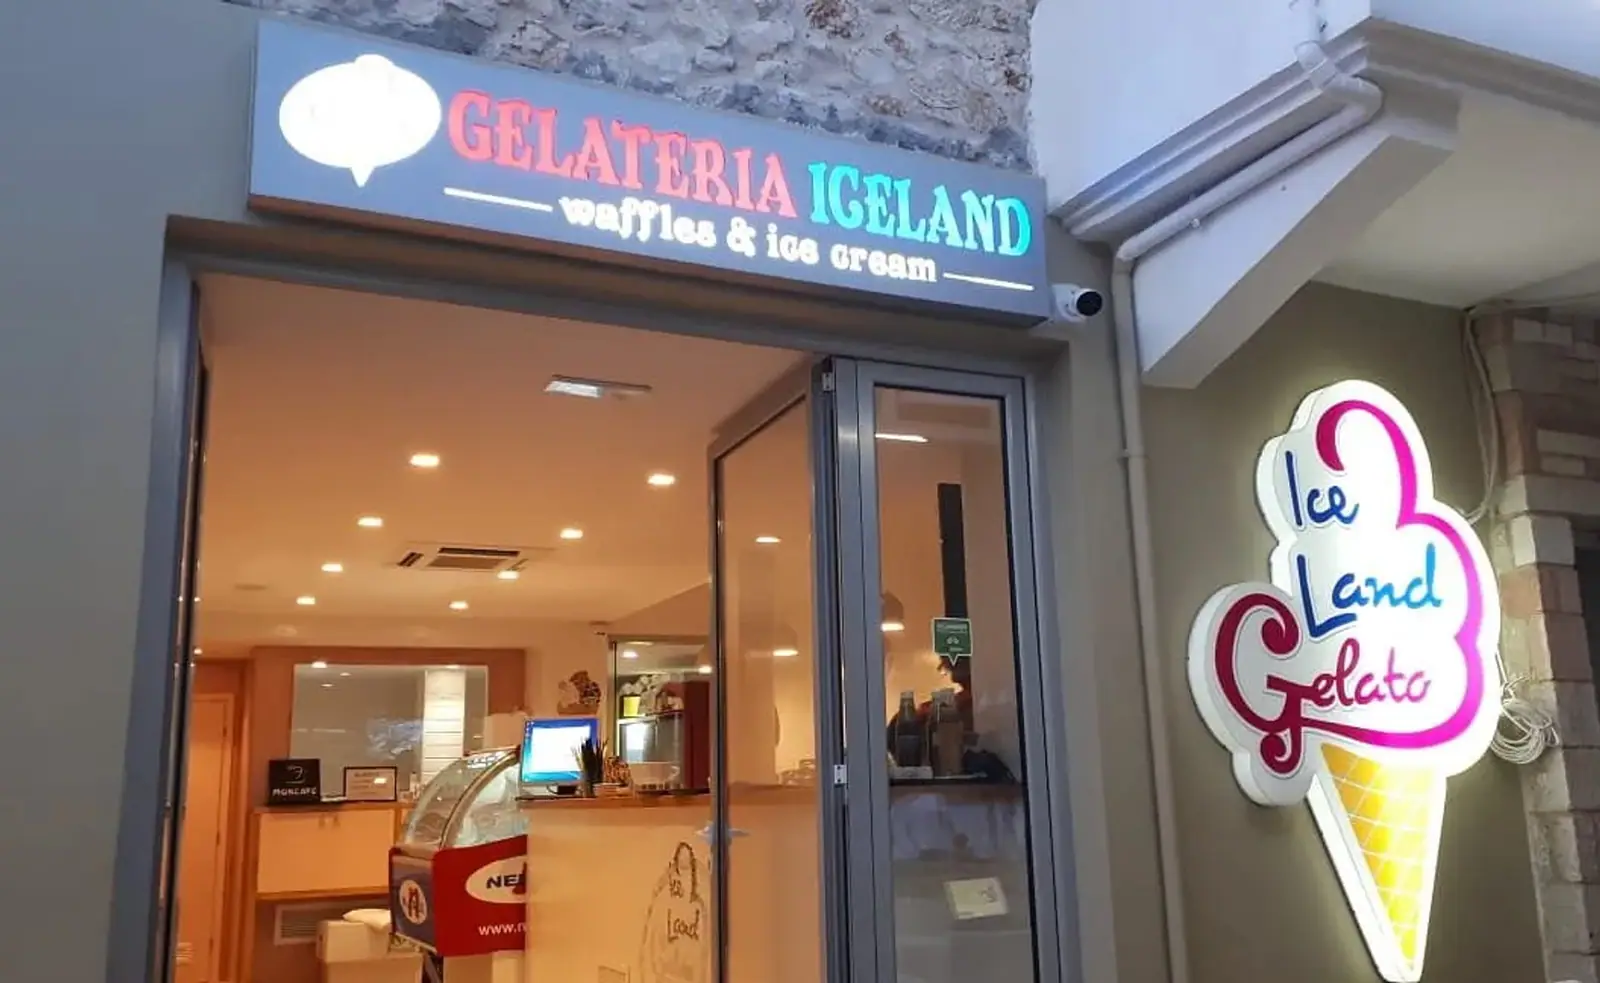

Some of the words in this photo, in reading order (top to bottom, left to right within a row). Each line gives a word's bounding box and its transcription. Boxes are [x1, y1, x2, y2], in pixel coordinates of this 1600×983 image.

[448, 90, 797, 219] GELATERIA
[809, 162, 1032, 257] ICELAND
[559, 196, 717, 248] waffles
[726, 216, 756, 257] &
[766, 223, 820, 265] ice
[830, 243, 937, 282] cream
[1285, 451, 1359, 526] Ice
[1298, 543, 1442, 637] Land
[1214, 593, 1431, 775] Gelato
